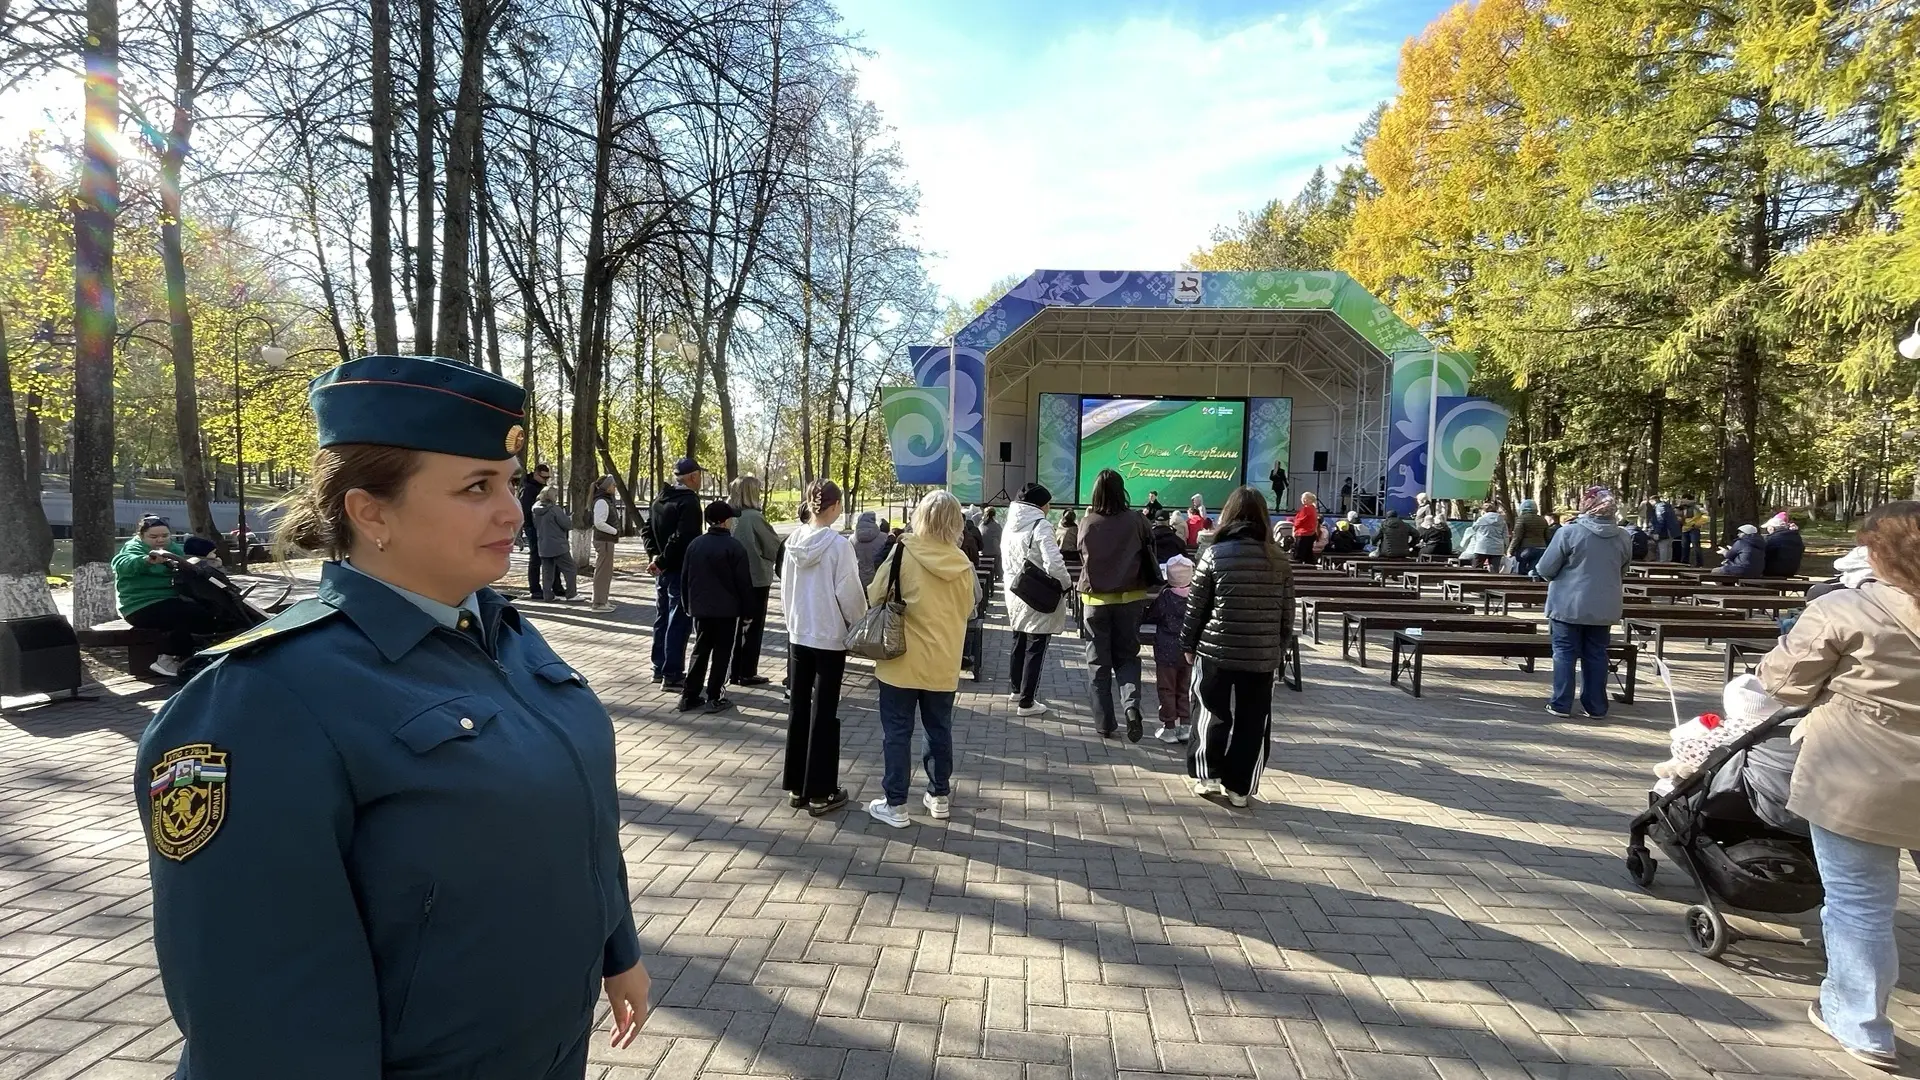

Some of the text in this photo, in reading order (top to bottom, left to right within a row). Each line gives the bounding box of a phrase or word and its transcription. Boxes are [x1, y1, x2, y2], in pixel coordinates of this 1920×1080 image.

[1118, 441, 1129, 461] С
[1174, 444, 1238, 461] Республики
[1118, 461, 1237, 481] Башкортостан!
[178, 825, 213, 855] ПОЖАРНАЯ
[212, 788, 221, 820] ОХРАНА
